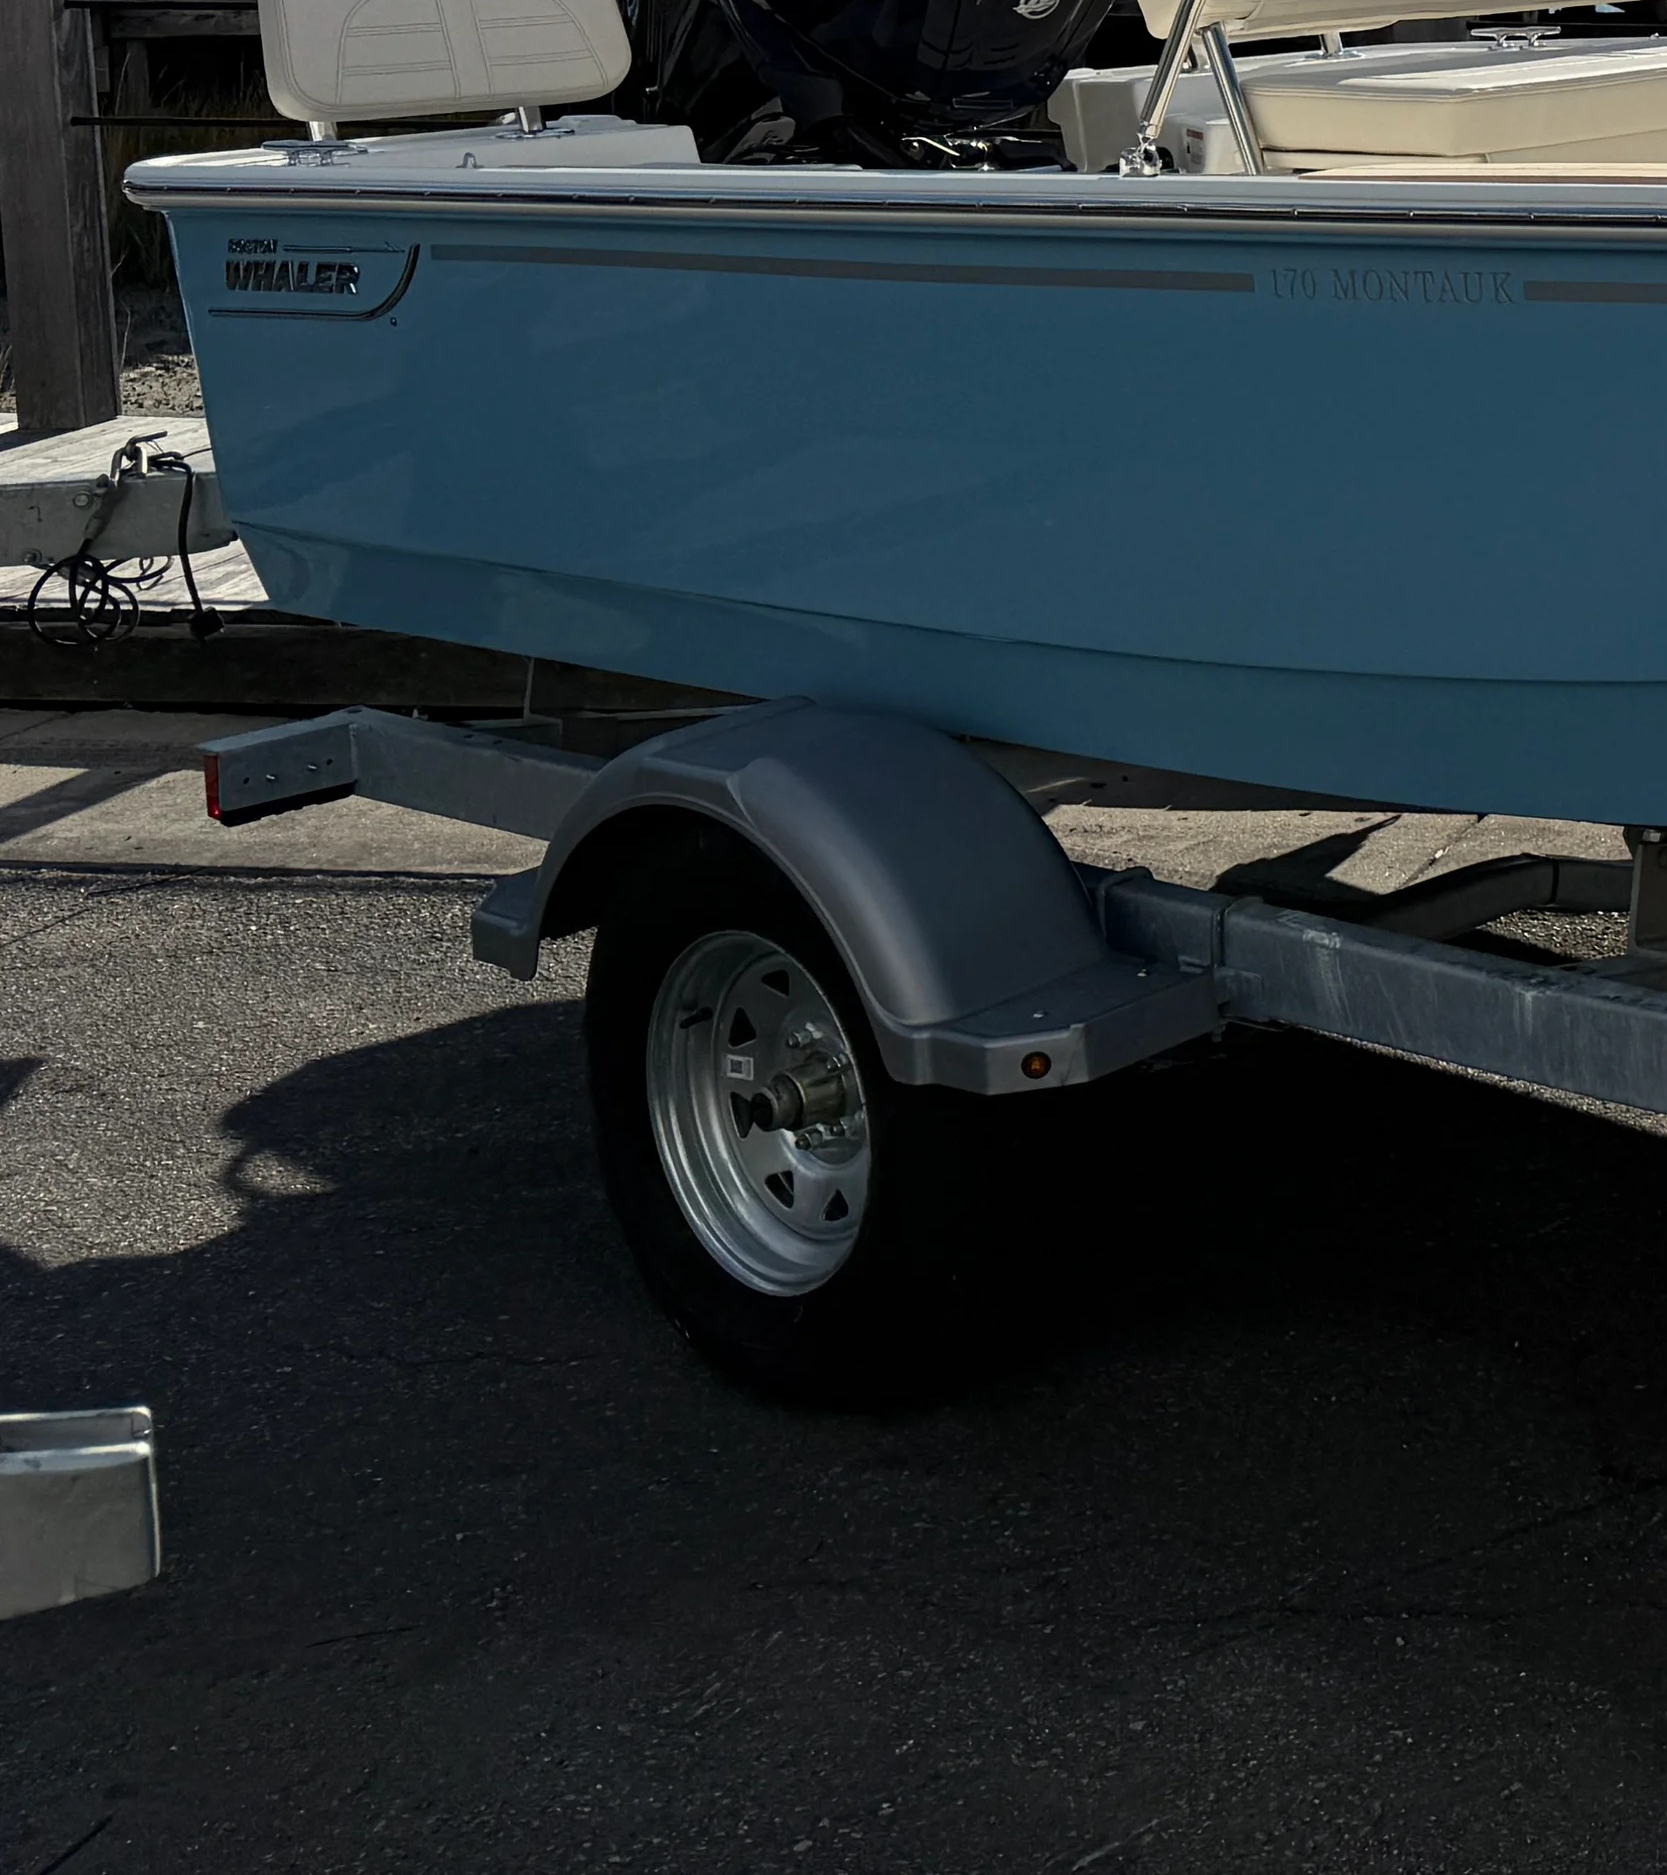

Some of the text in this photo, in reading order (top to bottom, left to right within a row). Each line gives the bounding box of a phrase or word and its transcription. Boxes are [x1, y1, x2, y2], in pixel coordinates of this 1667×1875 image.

[225, 260, 360, 295] WHALER
[1270, 268, 1517, 305] 170 MONTAUK
